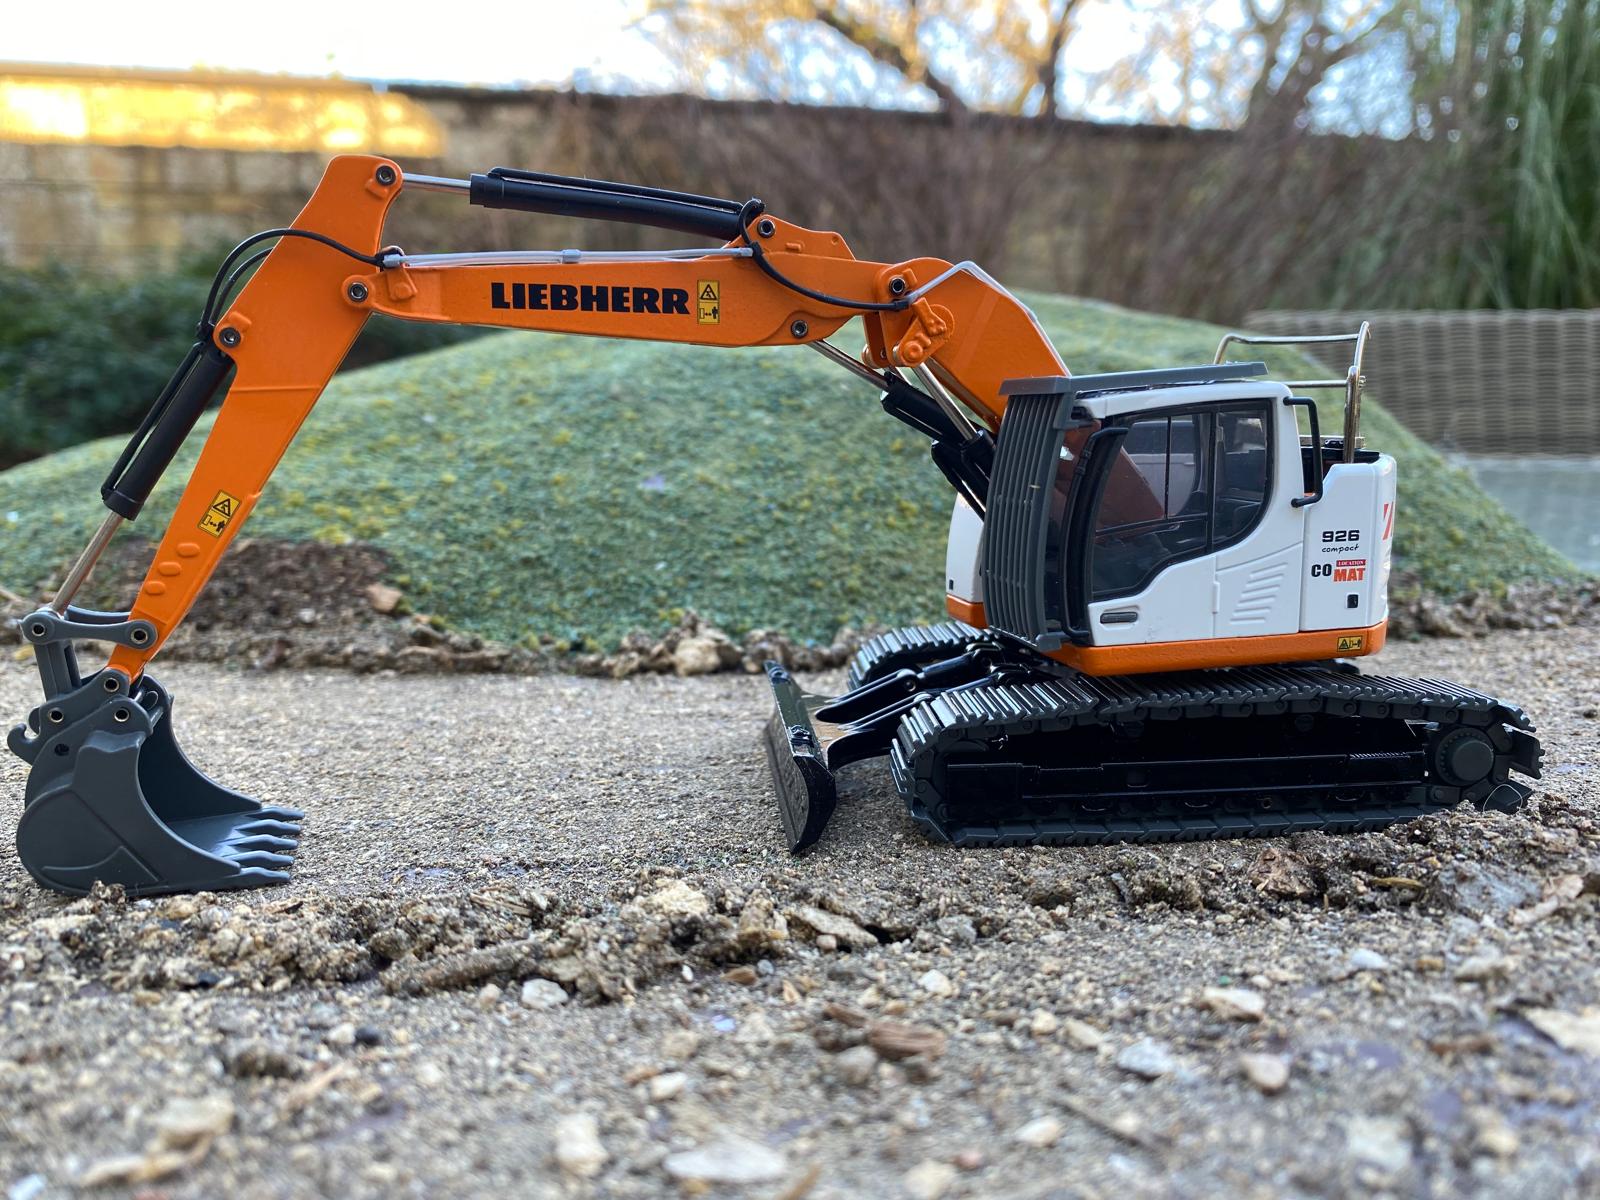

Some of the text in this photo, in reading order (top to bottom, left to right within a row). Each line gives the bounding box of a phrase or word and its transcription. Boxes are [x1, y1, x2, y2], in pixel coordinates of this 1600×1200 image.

[491, 282, 690, 314] LIEBHERR
[1322, 530, 1360, 542] 926
[1321, 544, 1359, 554] compact
